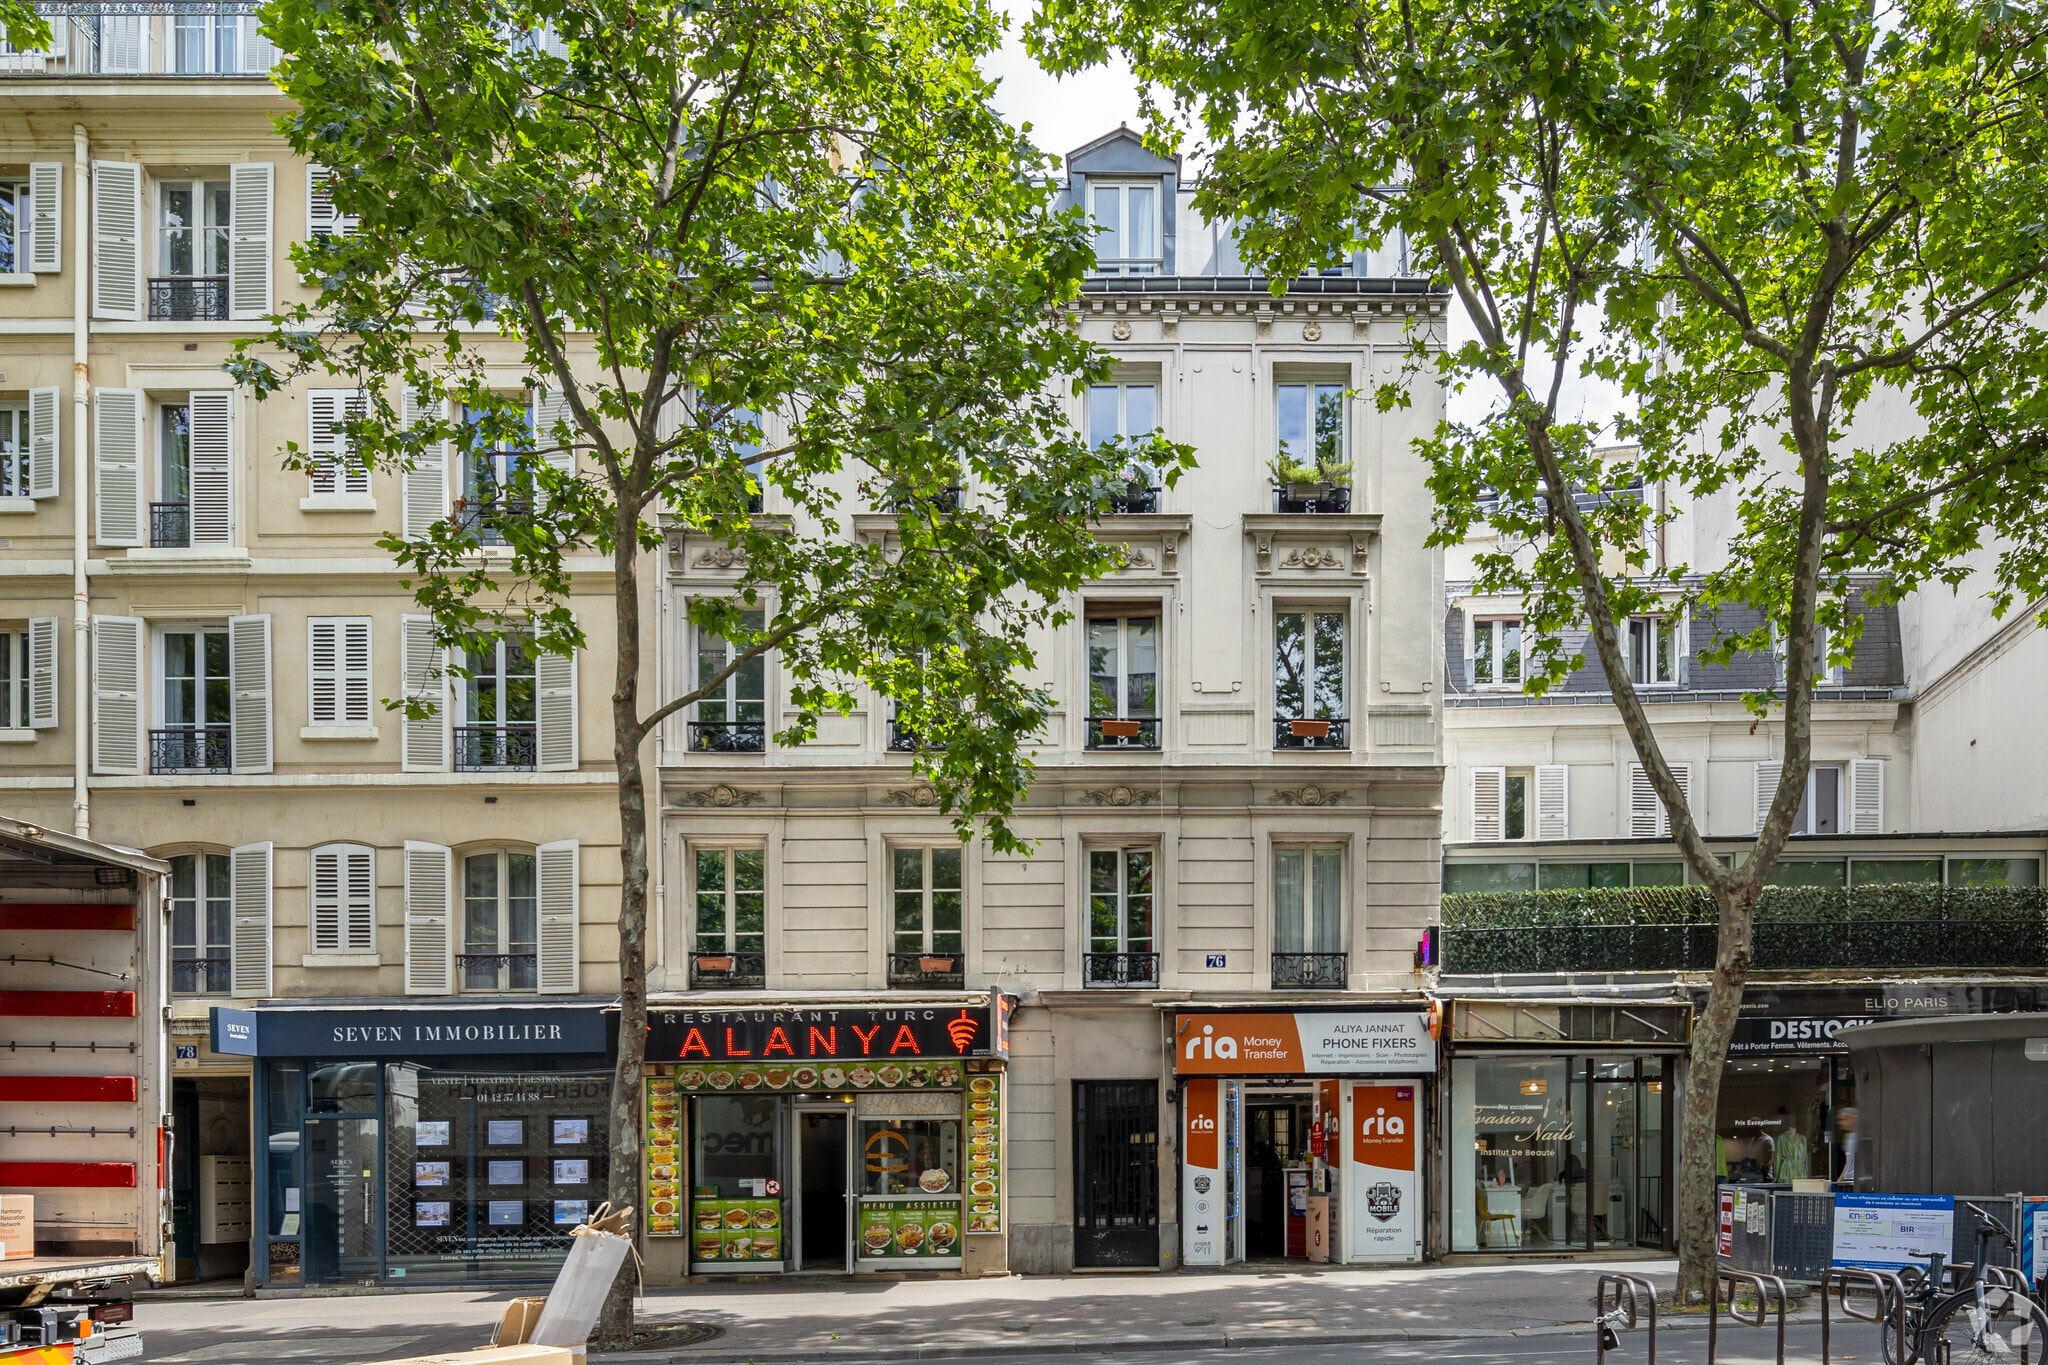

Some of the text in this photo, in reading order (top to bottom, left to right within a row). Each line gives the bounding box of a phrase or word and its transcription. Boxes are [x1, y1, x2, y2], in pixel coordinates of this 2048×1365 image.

[1208, 956, 1224, 967] 76
[1865, 997, 1948, 1008] ELIO PARIS
[664, 1010, 936, 1024] RESTAURANT TURC
[227, 1023, 250, 1034] SEVEN
[333, 1024, 563, 1042] SEVEN IMMOBILIER
[1333, 1024, 1405, 1034] ALIYA JANNAT
[679, 1025, 921, 1057] ALANYA
[1185, 1024, 1237, 1060] ria
[1244, 1036, 1282, 1047] Money
[1322, 1038, 1417, 1049] PHONE FIXERS
[1750, 1042, 1770, 1050] Porter
[178, 1046, 195, 1058] 78
[1243, 1049, 1288, 1060] Transfer
[432, 1077, 460, 1085] VENTE
[471, 1076, 515, 1084] LOCATION
[476, 1093, 488, 1102] 01
[528, 1092, 540, 1101] 88
[1191, 1114, 1214, 1130] ria
[1362, 1107, 1404, 1135] ria
[1515, 1120, 1575, 1141] Nails
[1525, 1148, 1555, 1156] Beauté
[863, 1201, 957, 1210] MENU ASSIETTE
